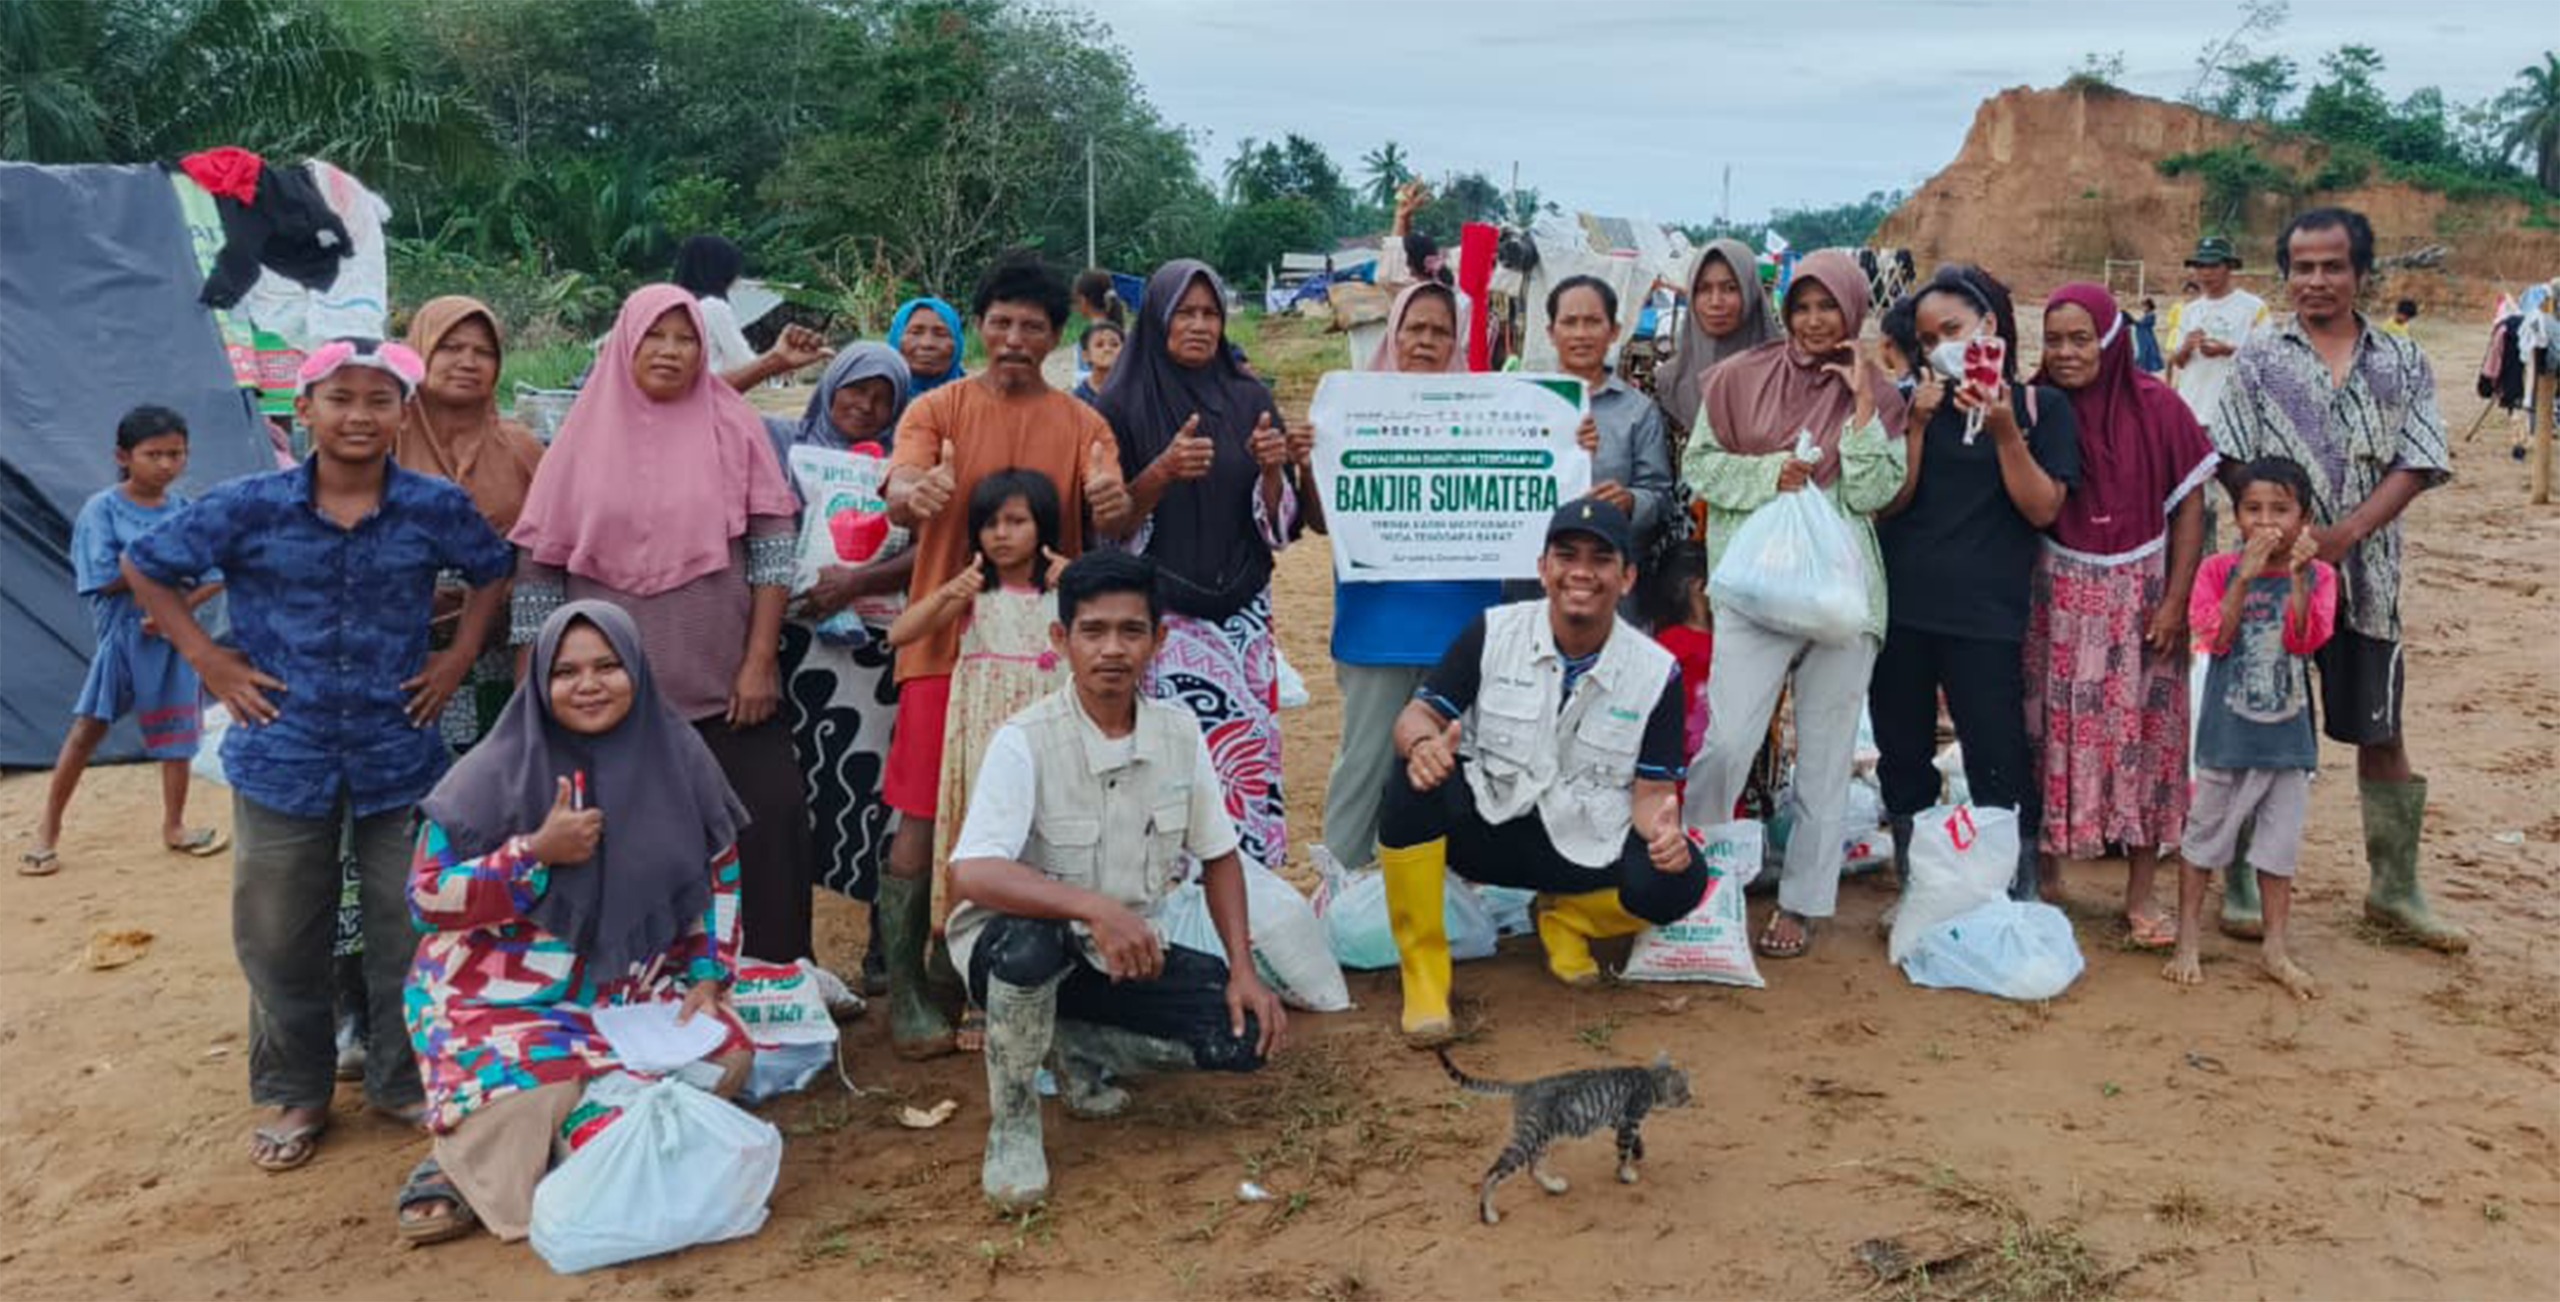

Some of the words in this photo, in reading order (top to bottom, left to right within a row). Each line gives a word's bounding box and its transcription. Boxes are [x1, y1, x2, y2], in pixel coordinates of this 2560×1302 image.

[1349, 453, 1421, 465] PENYALURAN
[1423, 453, 1476, 465] BANTUAN
[1336, 474, 1422, 512] BANJIR
[1430, 474, 1559, 512] SUMATERA
[1476, 532, 1514, 541] BARAT
